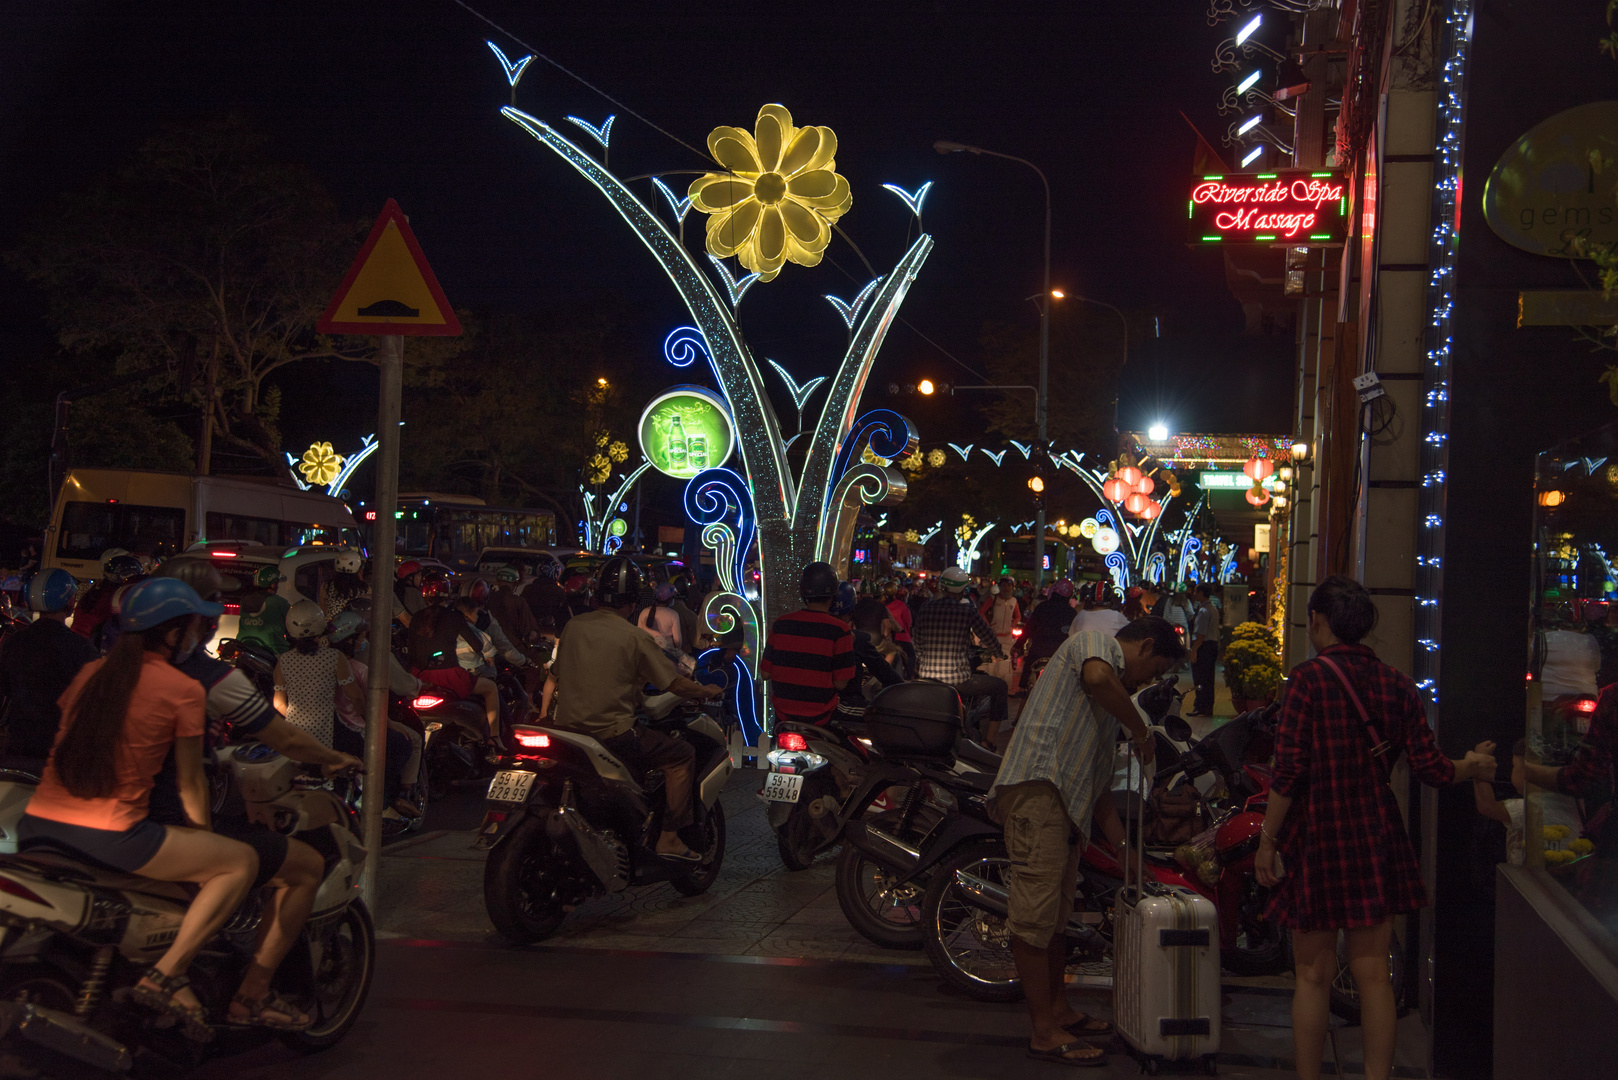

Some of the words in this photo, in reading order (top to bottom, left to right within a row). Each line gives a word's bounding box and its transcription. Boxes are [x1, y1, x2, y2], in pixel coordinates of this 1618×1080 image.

[1193, 181, 1288, 204] Riverside
[1291, 180, 1342, 210] Spa
[1216, 208, 1315, 237] Massage
[244, 617, 264, 626] Grab
[498, 772, 529, 787] 59-V2
[772, 775, 797, 788] 59-Y1
[488, 786, 527, 801] 628.99
[765, 787, 798, 801] 559.48
[146, 930, 179, 946] YAMA
